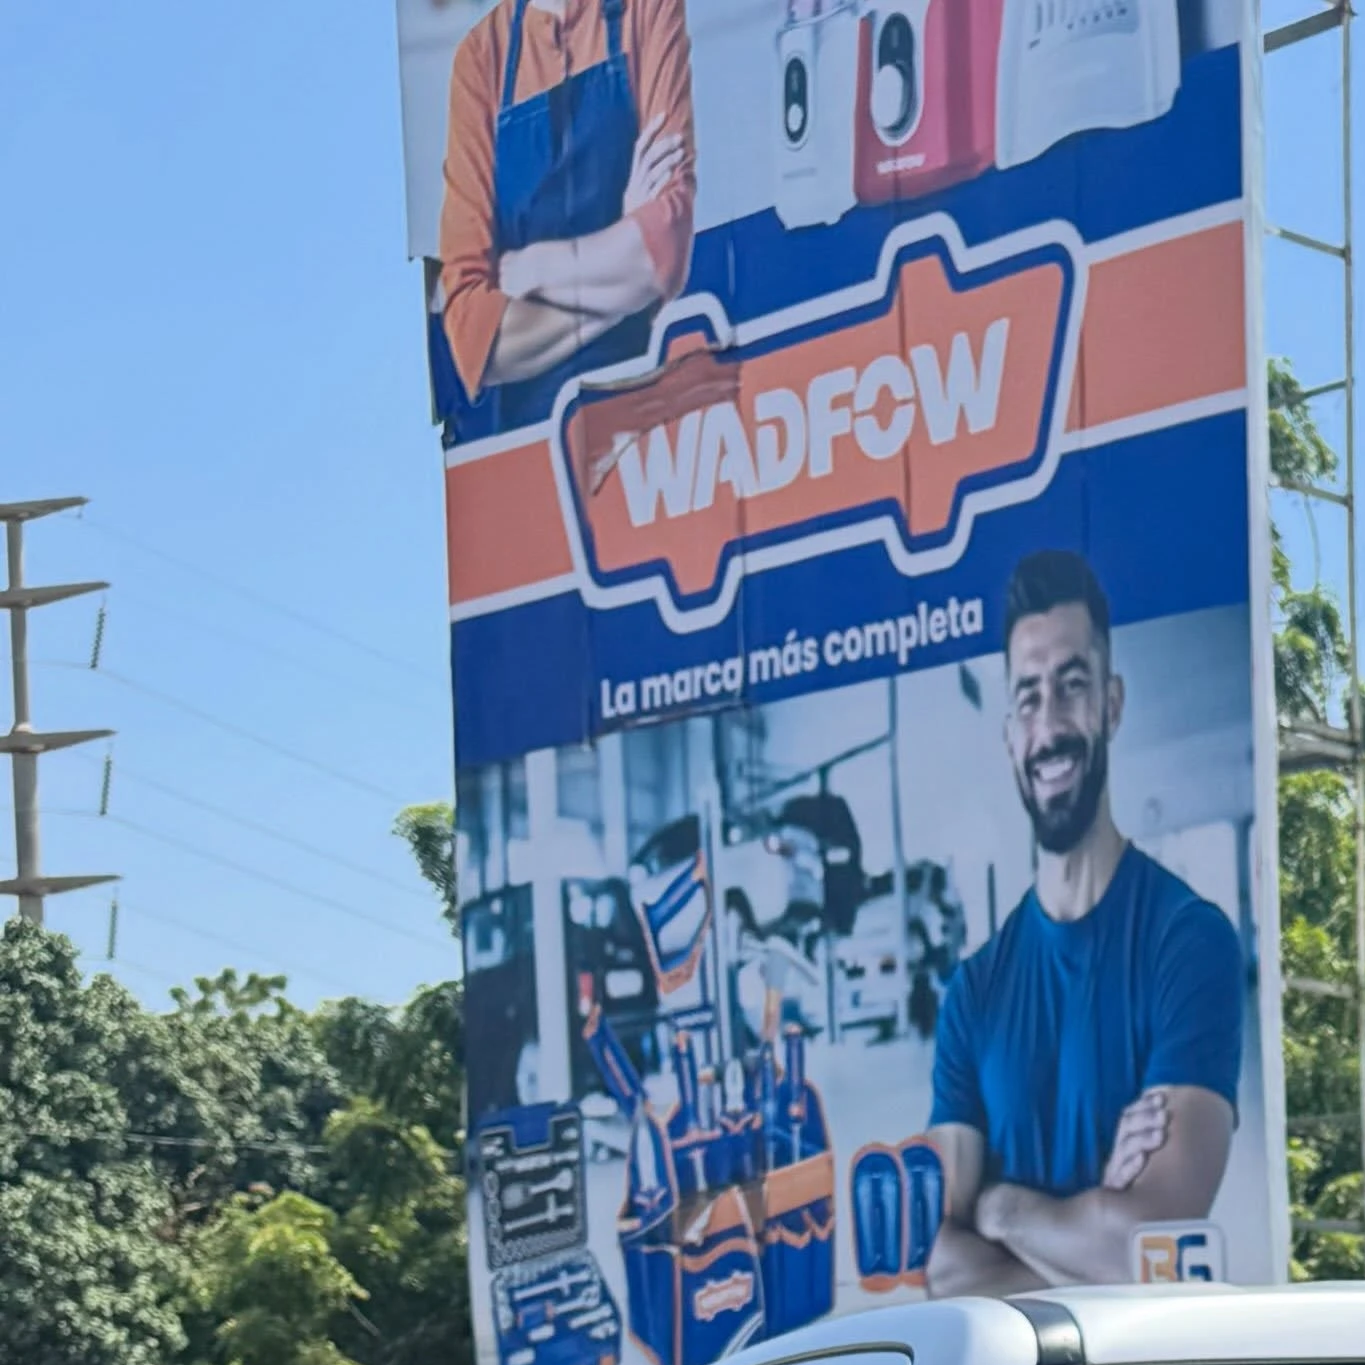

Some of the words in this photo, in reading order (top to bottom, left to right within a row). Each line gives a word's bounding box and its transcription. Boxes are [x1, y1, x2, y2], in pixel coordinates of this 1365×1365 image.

[612, 317, 1010, 528] WADFOW
[601, 677, 635, 719] La
[640, 655, 744, 710] marca
[748, 628, 819, 684] más
[823, 597, 984, 666] completa
